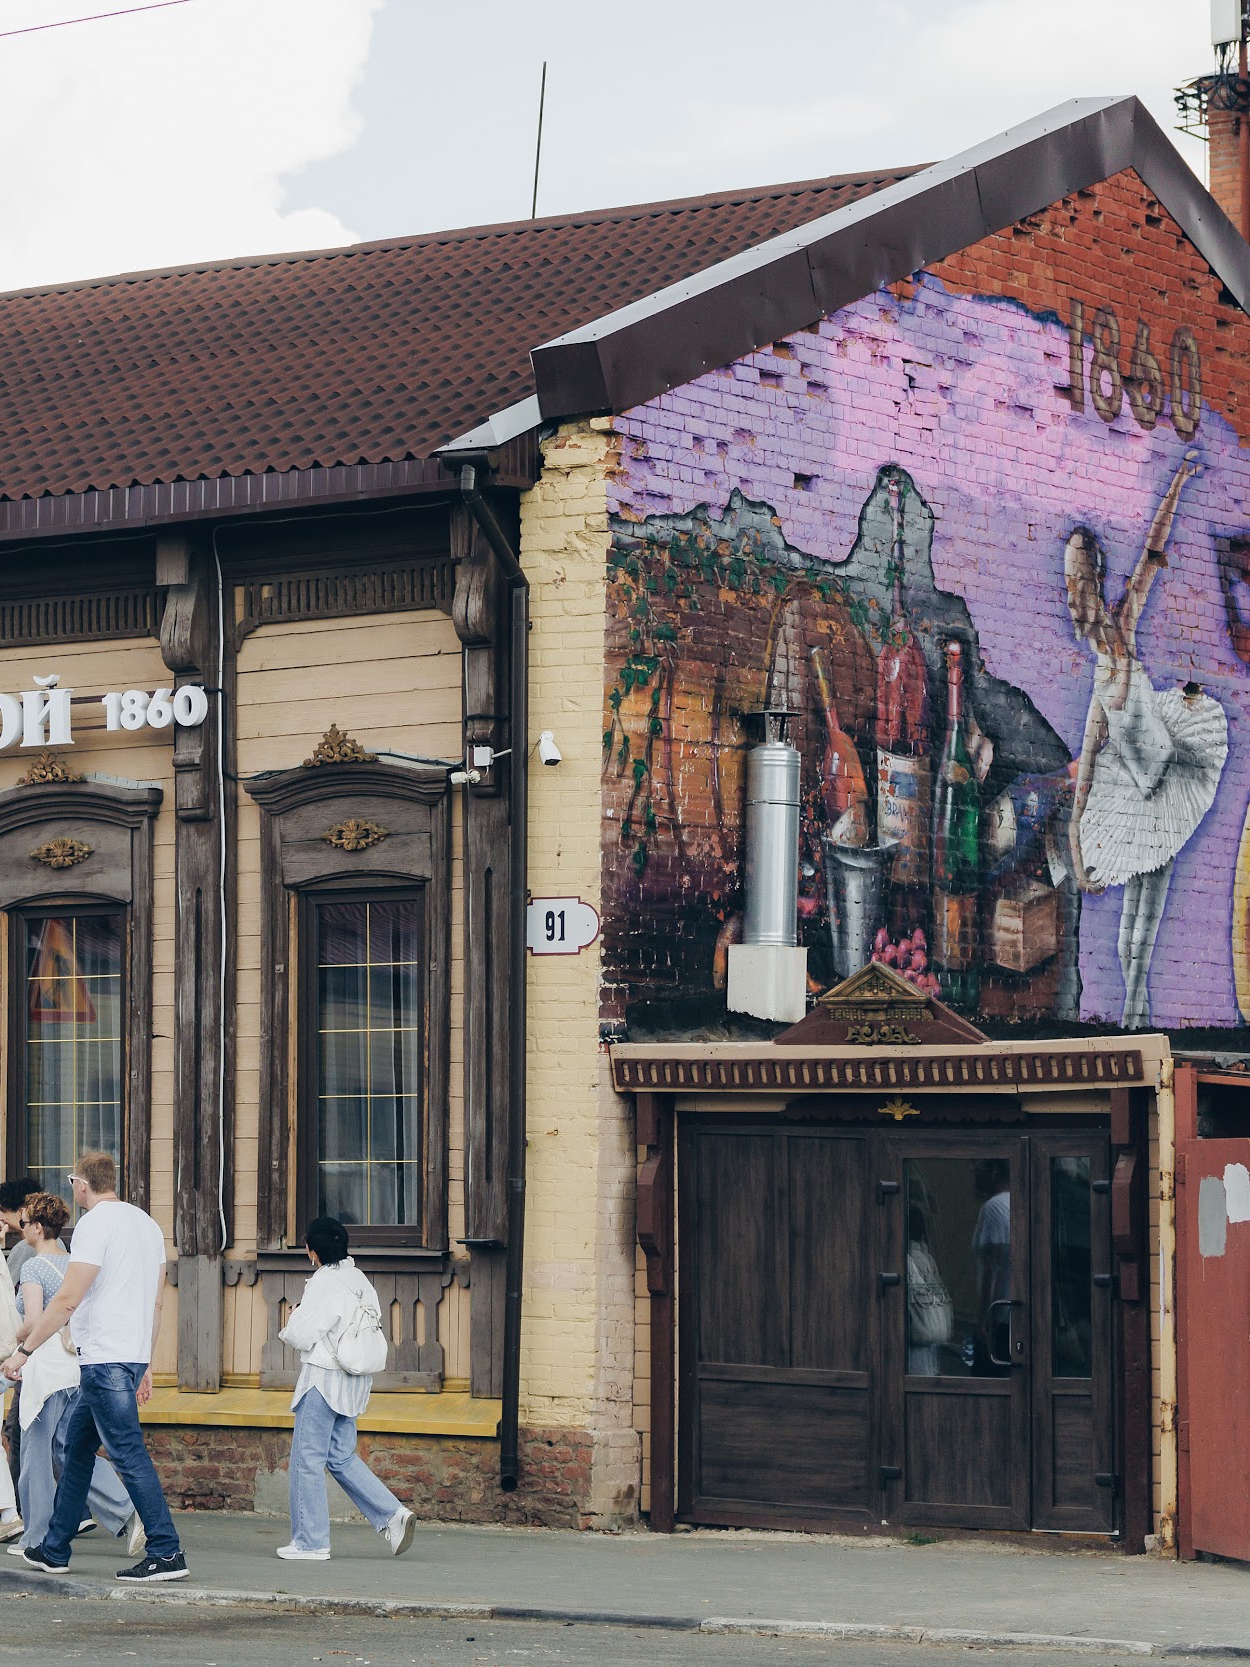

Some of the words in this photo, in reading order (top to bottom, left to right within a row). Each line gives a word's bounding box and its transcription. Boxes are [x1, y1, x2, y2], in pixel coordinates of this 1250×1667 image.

[1069, 298, 1203, 443] 1860
[101, 685, 208, 732] 1860
[545, 910, 566, 942] 91
